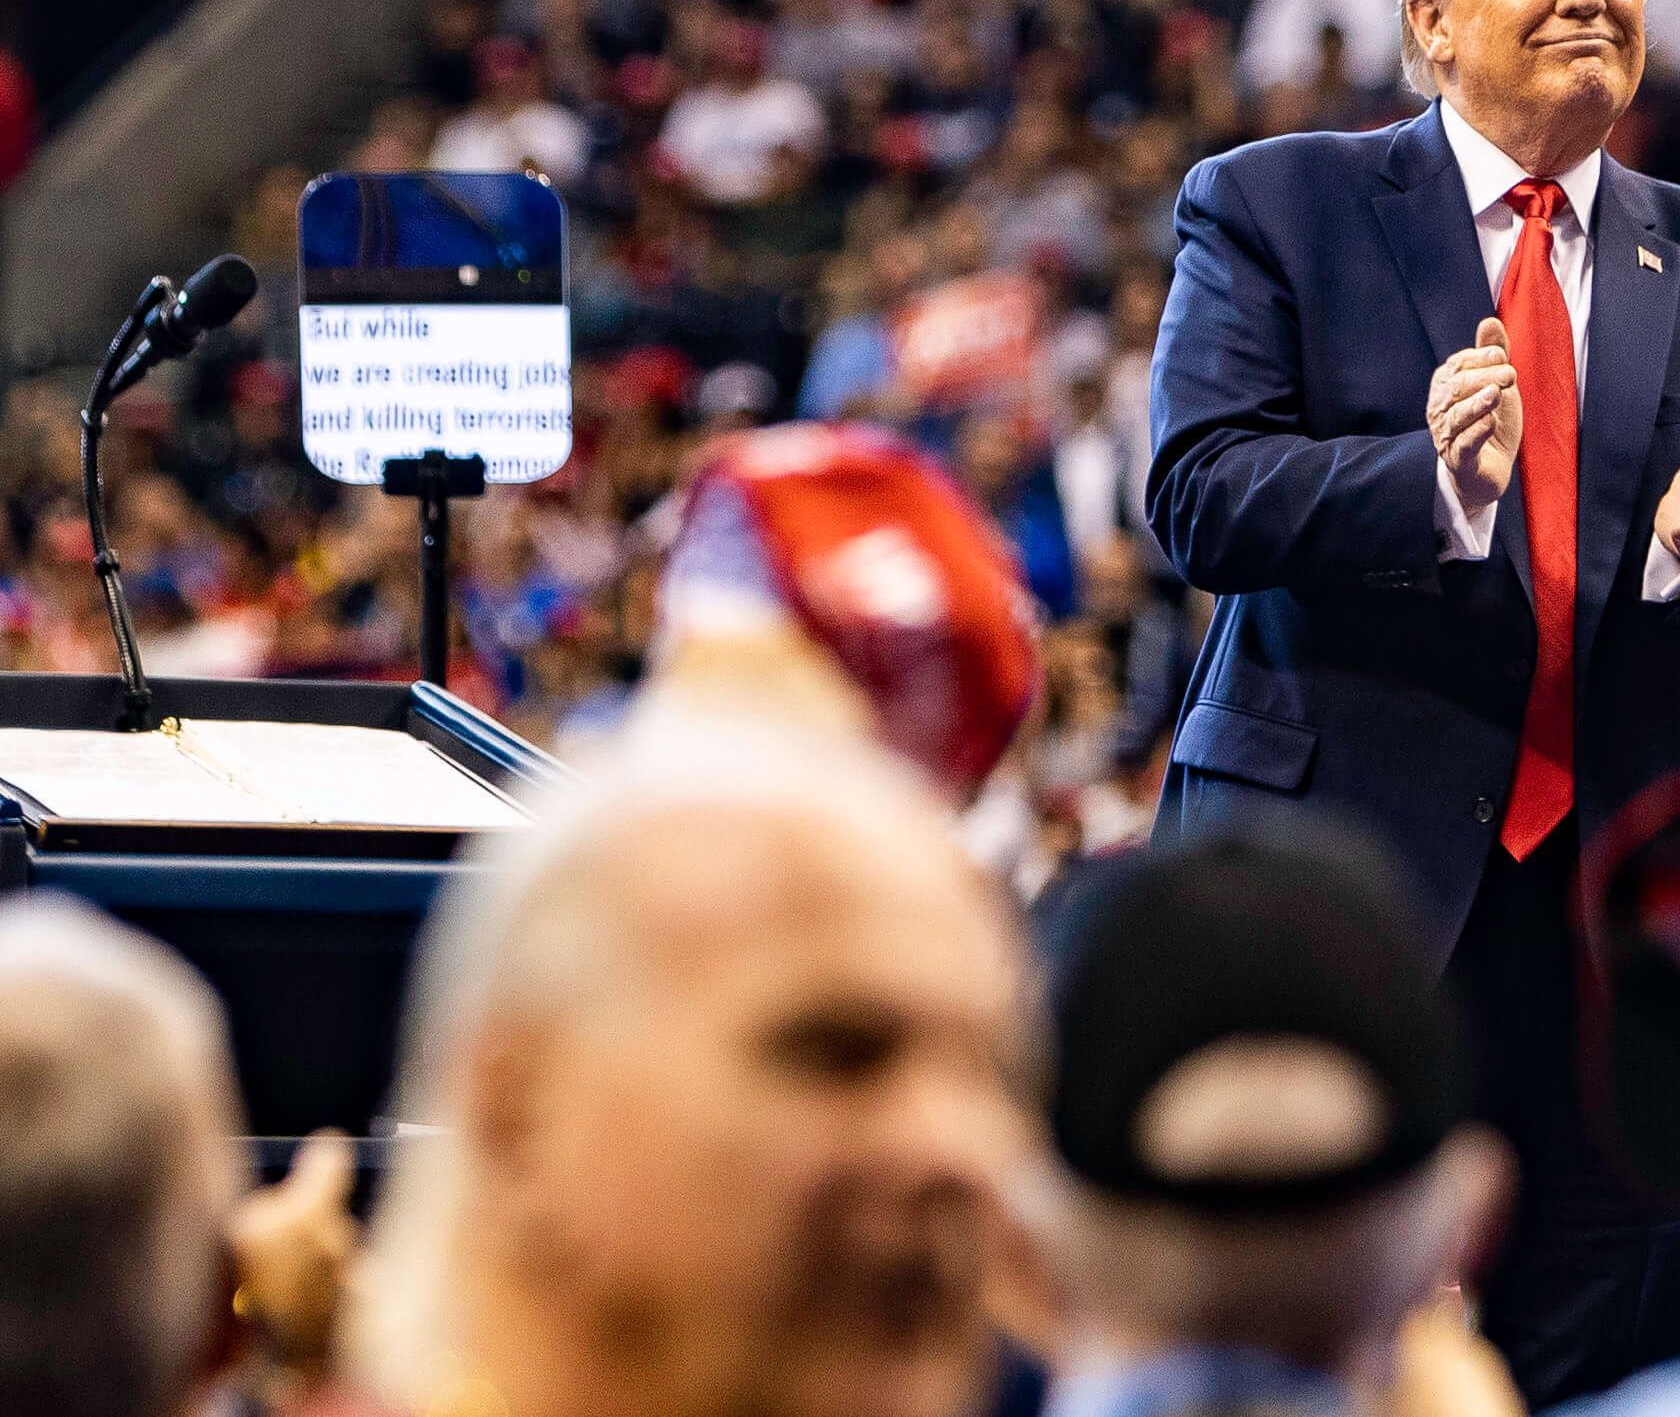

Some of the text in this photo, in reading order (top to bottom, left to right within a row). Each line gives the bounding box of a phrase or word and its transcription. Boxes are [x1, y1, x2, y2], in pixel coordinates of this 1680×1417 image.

[360, 308, 430, 339] while
[304, 356, 572, 390] we are creating jobs
[304, 405, 351, 431] and
[363, 402, 442, 435] killing
